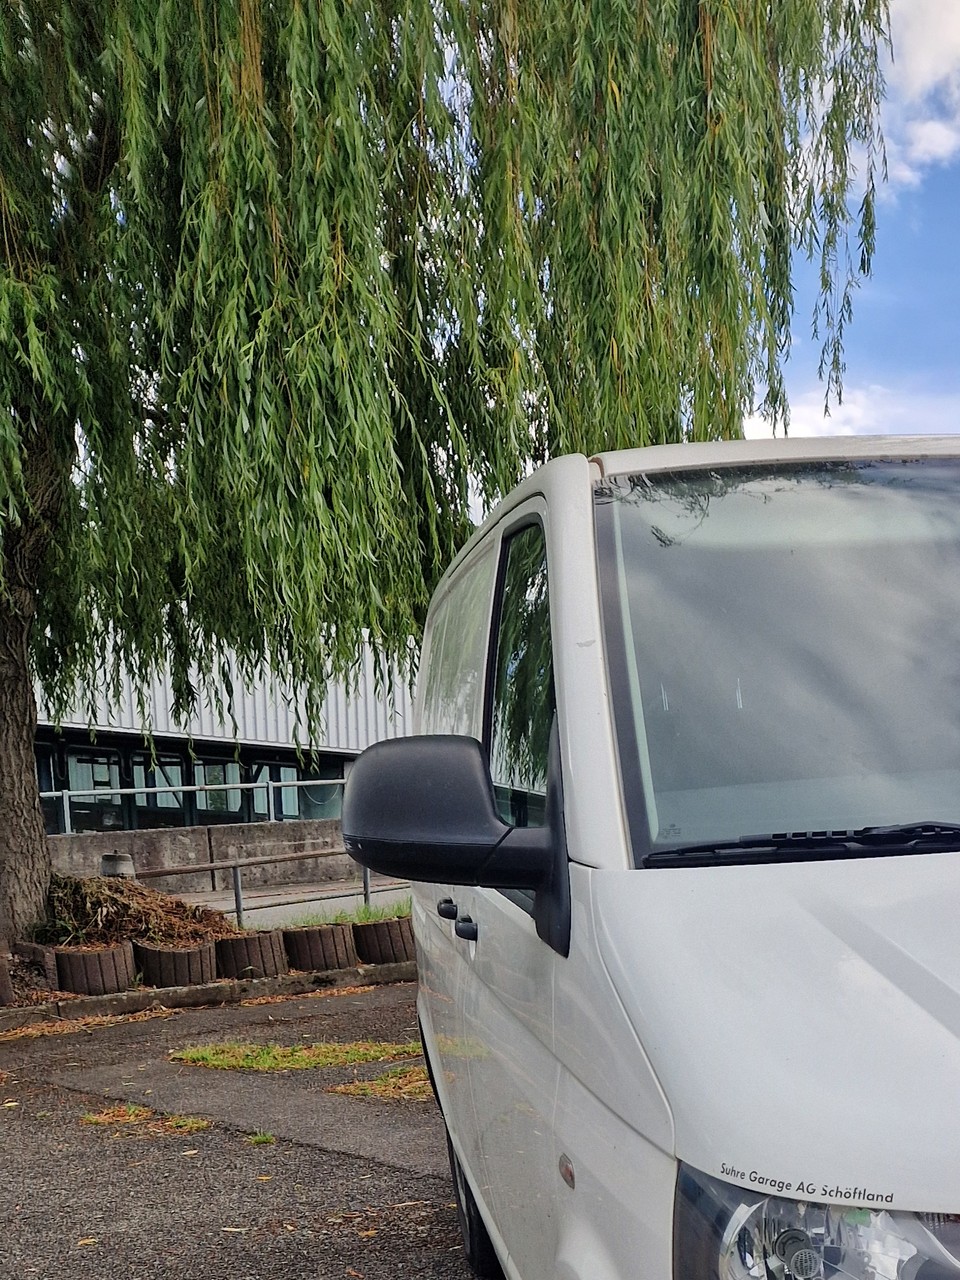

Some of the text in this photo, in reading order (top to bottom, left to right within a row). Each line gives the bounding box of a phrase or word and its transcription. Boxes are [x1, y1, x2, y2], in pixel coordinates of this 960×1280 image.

[720, 1162, 894, 1203] Suhre Garage AG Schöftland
